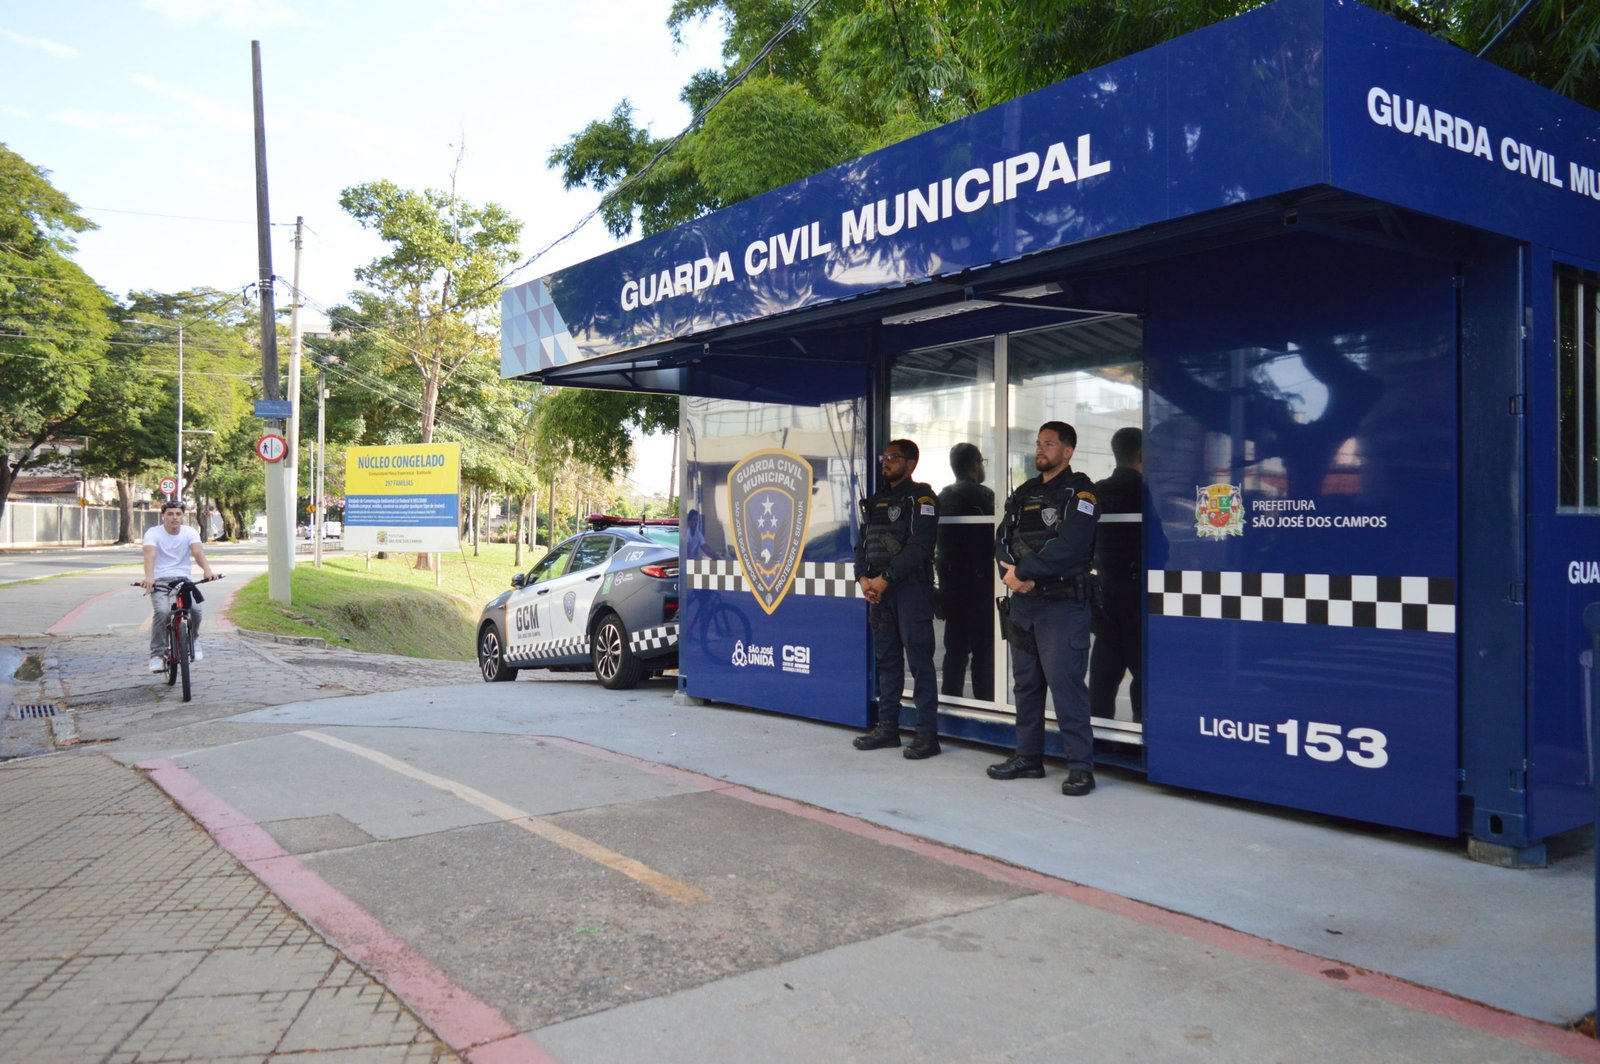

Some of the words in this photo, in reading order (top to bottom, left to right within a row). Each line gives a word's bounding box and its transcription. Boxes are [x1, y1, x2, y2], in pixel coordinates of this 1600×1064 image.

[1367, 86, 1493, 161] GUARDA
[1501, 137, 1563, 188] CIVIL
[1569, 161, 1600, 201] MU
[620, 250, 735, 312] GUARDA
[744, 220, 832, 276] CIVIL
[841, 133, 1111, 249] MUNICIPAL
[358, 454, 390, 469] NÚCLEO
[391, 454, 445, 468] CONGELADO
[736, 459, 775, 484] GUARDA
[777, 459, 803, 480] CIVIL
[162, 481, 174, 489] 50
[742, 472, 796, 494] MUNICIPAL
[1252, 500, 1316, 511] PREFEITURA
[795, 501, 804, 537] SERVIR
[1252, 515, 1275, 528] SÃO
[1276, 515, 1304, 528] JOSÉ
[1306, 516, 1332, 528] DOS
[1333, 516, 1387, 528] CAMPOS
[793, 538, 799, 546] E
[774, 548, 797, 593] PROTEGER
[1568, 560, 1600, 584] GUA
[516, 604, 539, 631] GCM
[748, 644, 760, 654] SÃO
[760, 646, 774, 655] JOSÉ
[748, 653, 775, 667] UNIDA
[782, 645, 810, 664] CSI
[1200, 716, 1270, 745] LIGUE
[1276, 719, 1389, 769] 153
